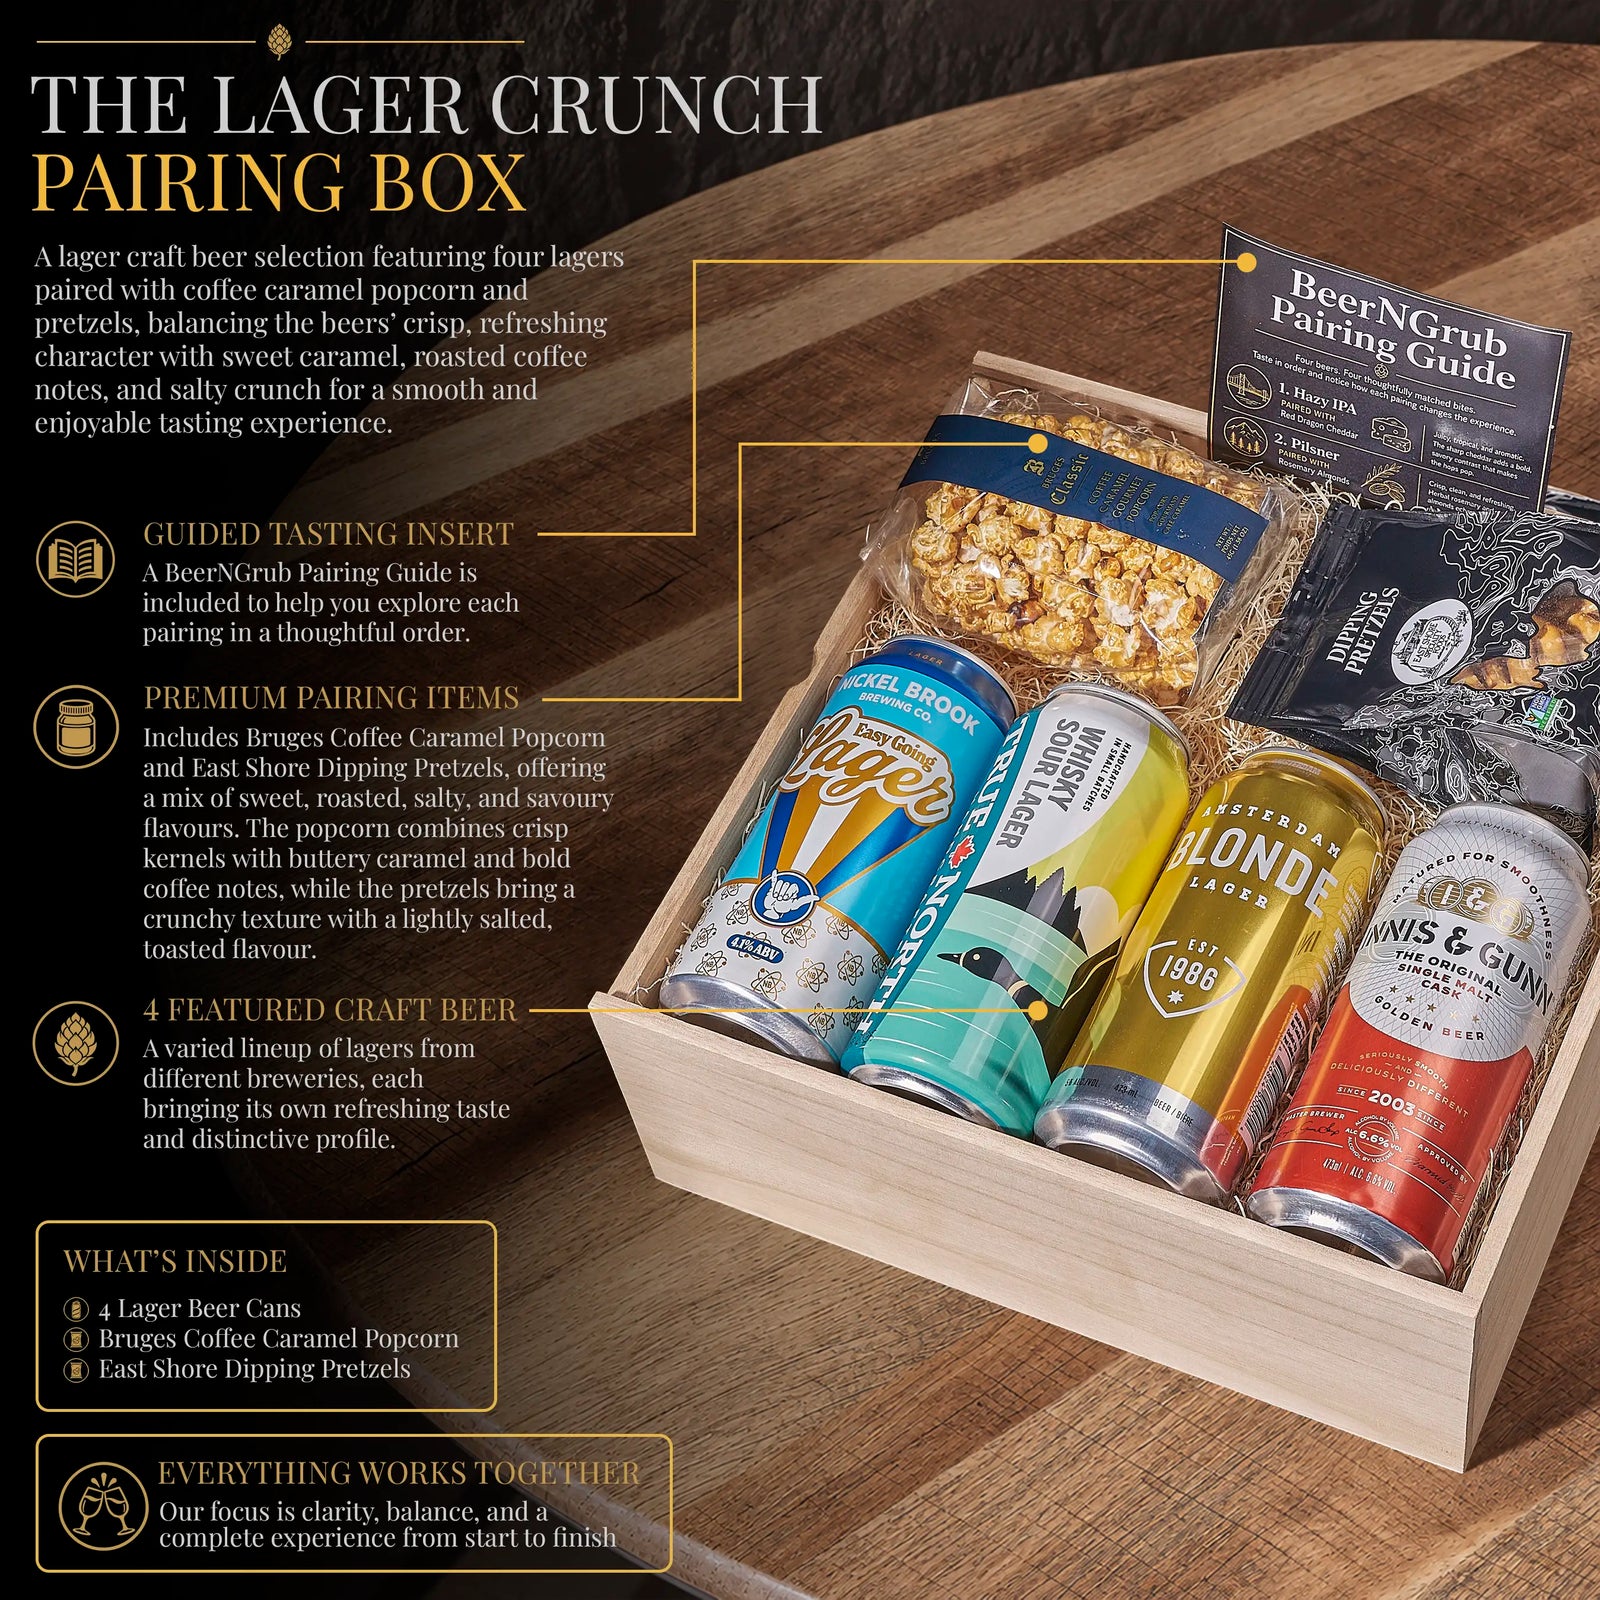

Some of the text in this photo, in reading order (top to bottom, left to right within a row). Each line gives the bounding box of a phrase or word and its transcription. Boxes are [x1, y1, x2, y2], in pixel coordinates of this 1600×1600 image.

[1290, 268, 1508, 358] BeerNGrub
[1270, 294, 1516, 390] Pairing Guide
[1252, 350, 1274, 364] Taste
[1284, 361, 1306, 375] order
[1307, 368, 1323, 380] and
[1325, 373, 1350, 388] notice
[1351, 381, 1369, 394] how
[1369, 388, 1389, 400] each
[1390, 393, 1418, 410] pairing
[1418, 402, 1452, 420] changes
[1454, 413, 1468, 423] the
[1469, 418, 1517, 437] experience.
[1278, 382, 1358, 416] 1. Hazy IPA
[1295, 353, 1476, 414] Four beers. Four thoughtfully matched bites.
[1280, 399, 1337, 423] PAIRED WITH
[1280, 409, 1359, 440] Red Dragon Cheddar
[1273, 432, 1341, 462] 2. Pilsner
[1277, 448, 1331, 470] PAIRED WITH
[1278, 457, 1316, 476] Rosemary
[1430, 459, 1442, 468] the
[1442, 462, 1459, 472] hops
[1041, 456, 1066, 489] BRUGES
[1050, 453, 1090, 506] Classic
[1088, 470, 1114, 505] COFFEE
[1099, 472, 1131, 513] CARAMEL
[1112, 475, 1145, 519] GOURMET
[1126, 481, 1158, 523] POPCORN
[1326, 591, 1378, 664] DIPPING
[1344, 586, 1400, 676] PRETZELS
[1413, 622, 1438, 663] EAST SHORE
[908, 651, 944, 666] LAGER
[839, 672, 981, 737] NICKEL BROOK
[858, 692, 933, 724] BREWING CO.
[784, 712, 947, 817] Lager
[853, 722, 938, 773] Easy Going
[962, 715, 1030, 833] TRUE
[995, 718, 1081, 849] SOUR LAGER
[1047, 725, 1107, 813] WHISKY
[1082, 737, 1123, 812] IN SMALL BATCHES
[1100, 741, 1132, 801] HANDCRAFTED
[1201, 803, 1343, 860] AMSTERDAM
[1166, 827, 1339, 919] BLONDE
[1189, 876, 1269, 910] LAGER
[1392, 851, 1553, 961] MATURED FOR SMOOTHNESS
[729, 936, 780, 961] 4.1% ABV
[1187, 938, 1219, 958] EST
[1159, 955, 1219, 991] 1986
[1393, 950, 1505, 997] THE ORIGINAL
[1397, 963, 1493, 1004] SINGLE MALT
[1421, 979, 1461, 1001] CASK
[1443, 926, 1474, 956] &
[1479, 941, 1554, 1017] GUNN
[1374, 994, 1485, 1041] GOLDEN BEER
[1330, 1061, 1470, 1119] DELICIOUSLY DIFFERENT
[1359, 1051, 1450, 1091] SERIOUSLY SMOOTH
[1394, 1064, 1413, 1075] AND
[1153, 1098, 1172, 1113] BEER
[1309, 1110, 1346, 1120] BREWER
[1337, 1085, 1446, 1131] SINCE 2003 SINCE
[1345, 1127, 1358, 1135] ALC
[1358, 1130, 1390, 1149] 6.6%
[1390, 1143, 1404, 1153] VOL
[1322, 1157, 1397, 1195] 473ml ALC. 6.6% VOL.
[1417, 1143, 1460, 1177] APPROVED
[1459, 1173, 1469, 1185] BY
